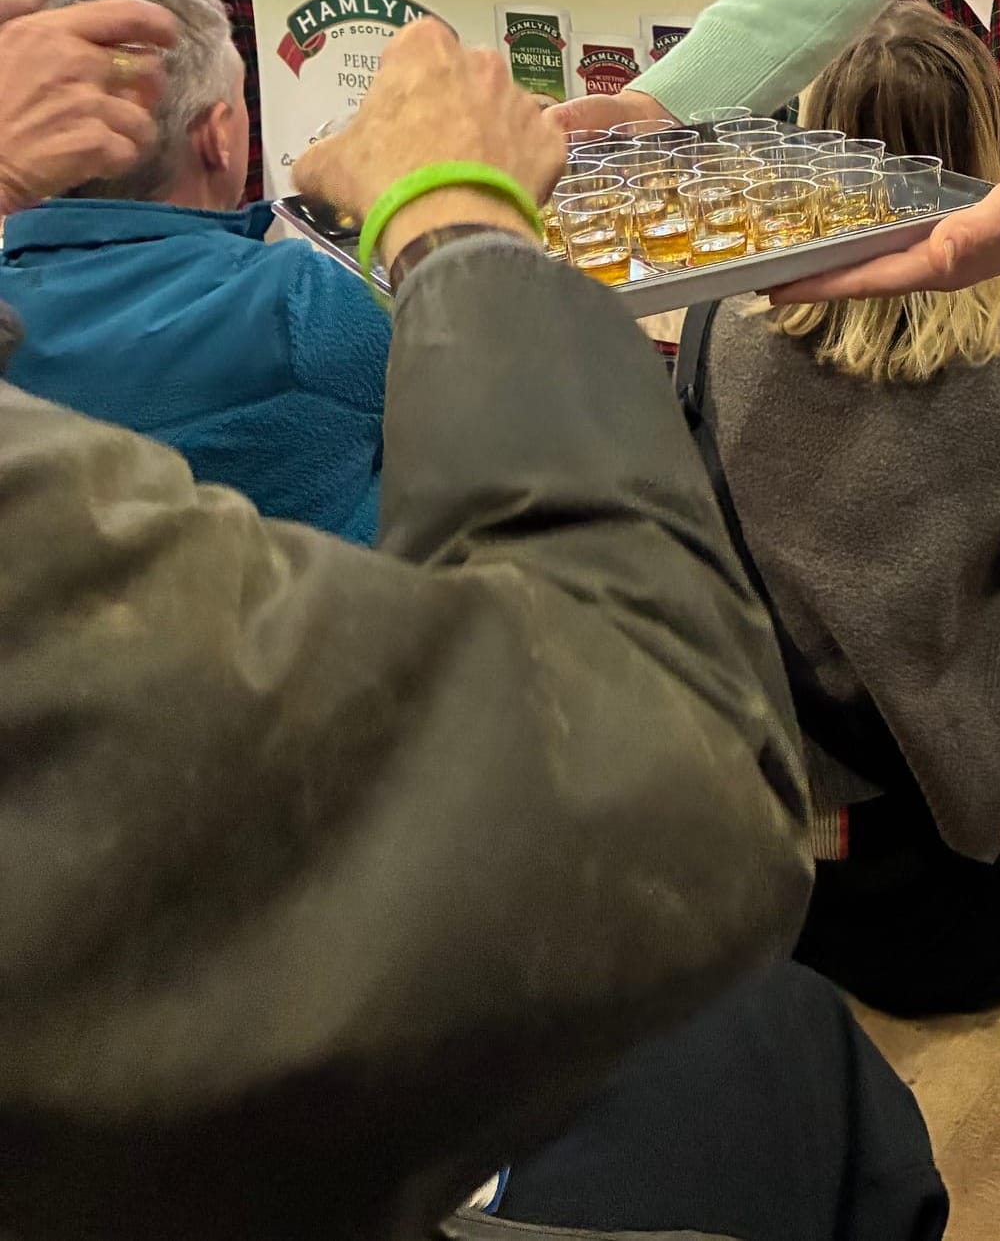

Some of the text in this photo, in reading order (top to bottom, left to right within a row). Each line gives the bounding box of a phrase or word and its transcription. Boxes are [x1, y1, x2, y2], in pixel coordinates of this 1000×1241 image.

[331, 25, 395, 39] OF SCOTLA
[509, 21, 558, 38] HAMLYNS
[343, 53, 382, 72] PERF
[511, 52, 562, 68] PORRIDGE
[583, 52, 637, 70] HAMLYNS
